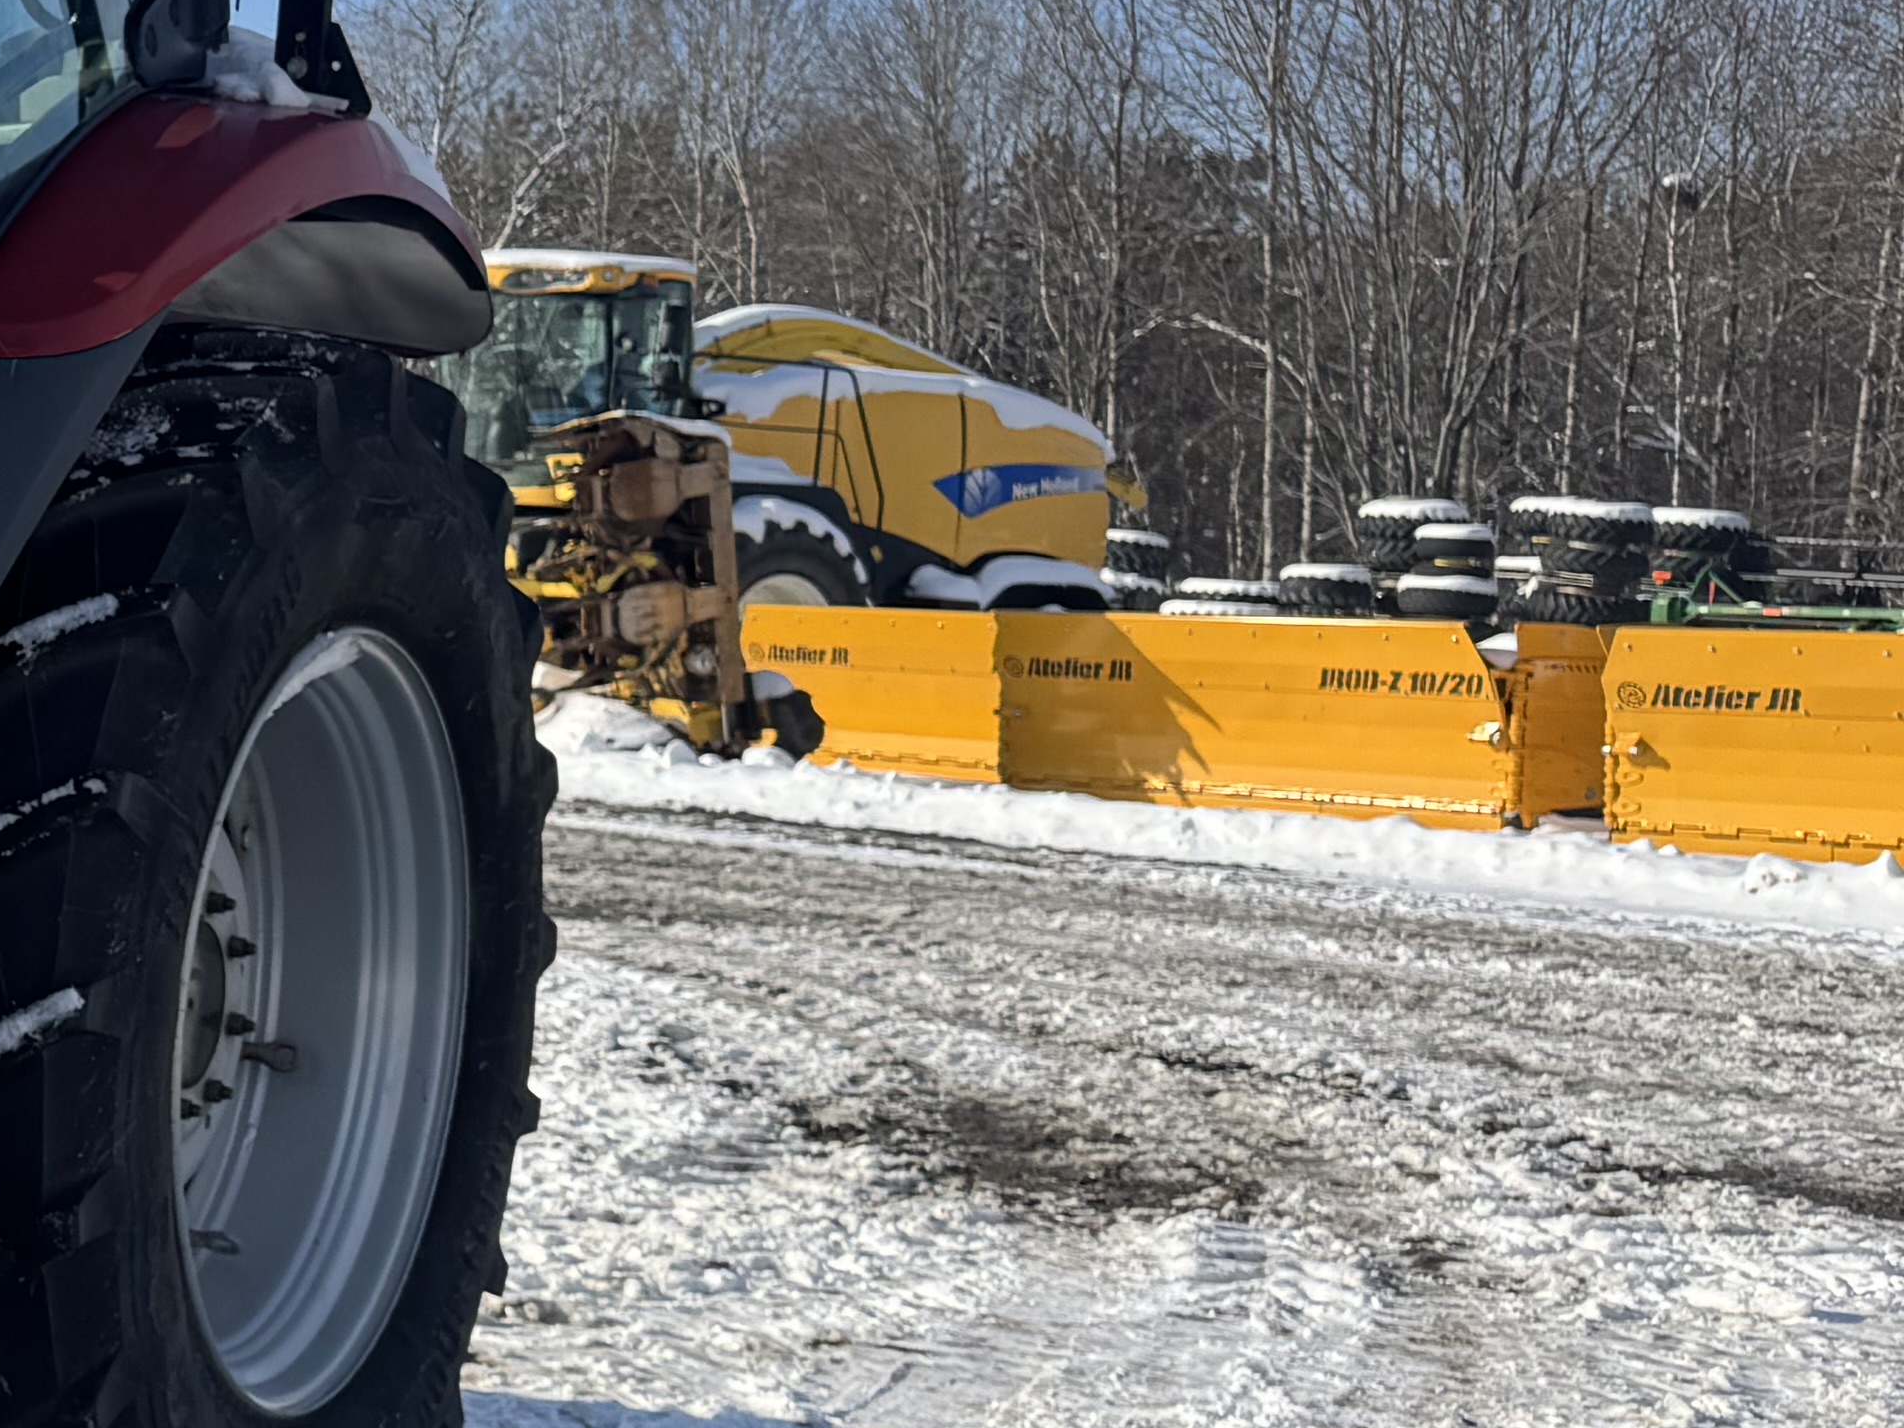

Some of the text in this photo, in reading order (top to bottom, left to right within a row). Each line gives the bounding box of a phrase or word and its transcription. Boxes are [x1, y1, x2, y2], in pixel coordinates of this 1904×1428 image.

[1028, 657, 1104, 680] Atelier
[1650, 683, 1803, 712] Atelier JR
